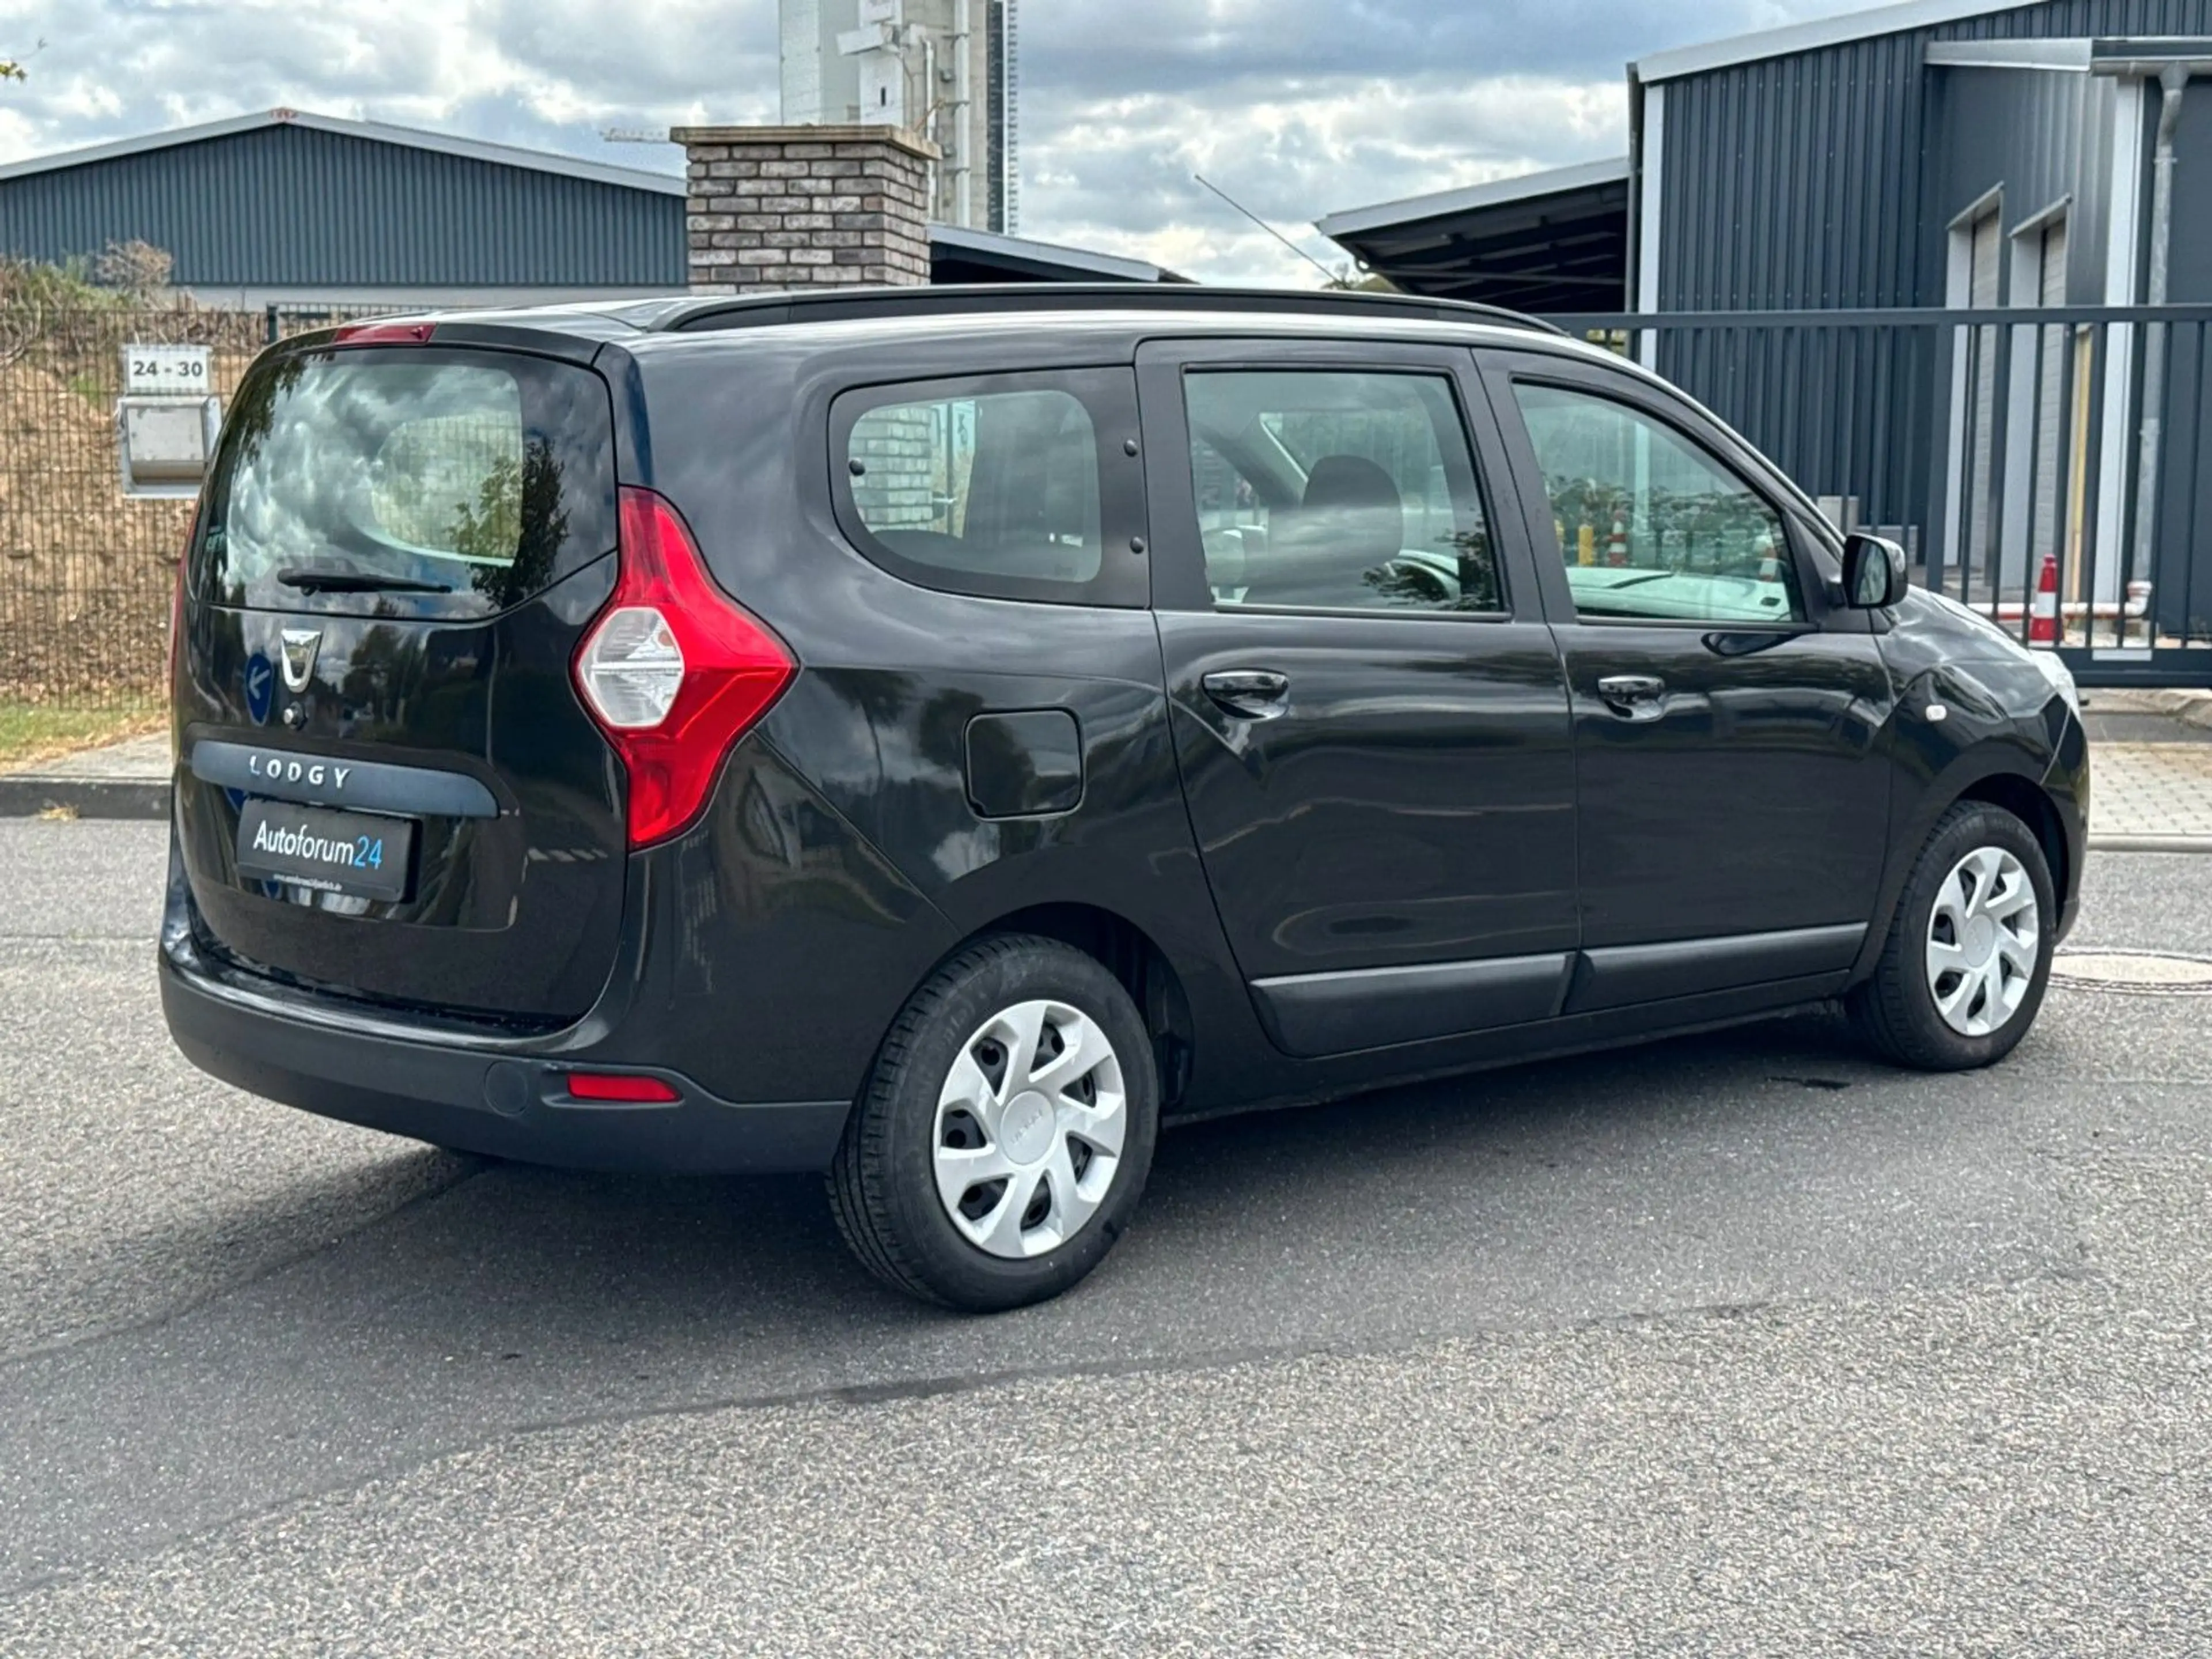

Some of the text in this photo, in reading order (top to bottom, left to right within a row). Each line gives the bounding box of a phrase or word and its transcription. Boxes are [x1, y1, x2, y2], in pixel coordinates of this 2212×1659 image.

[134, 360, 158, 377] 24
[177, 361, 203, 377] 30
[249, 755, 351, 789] LODGY
[252, 819, 382, 870] Autoforum24
